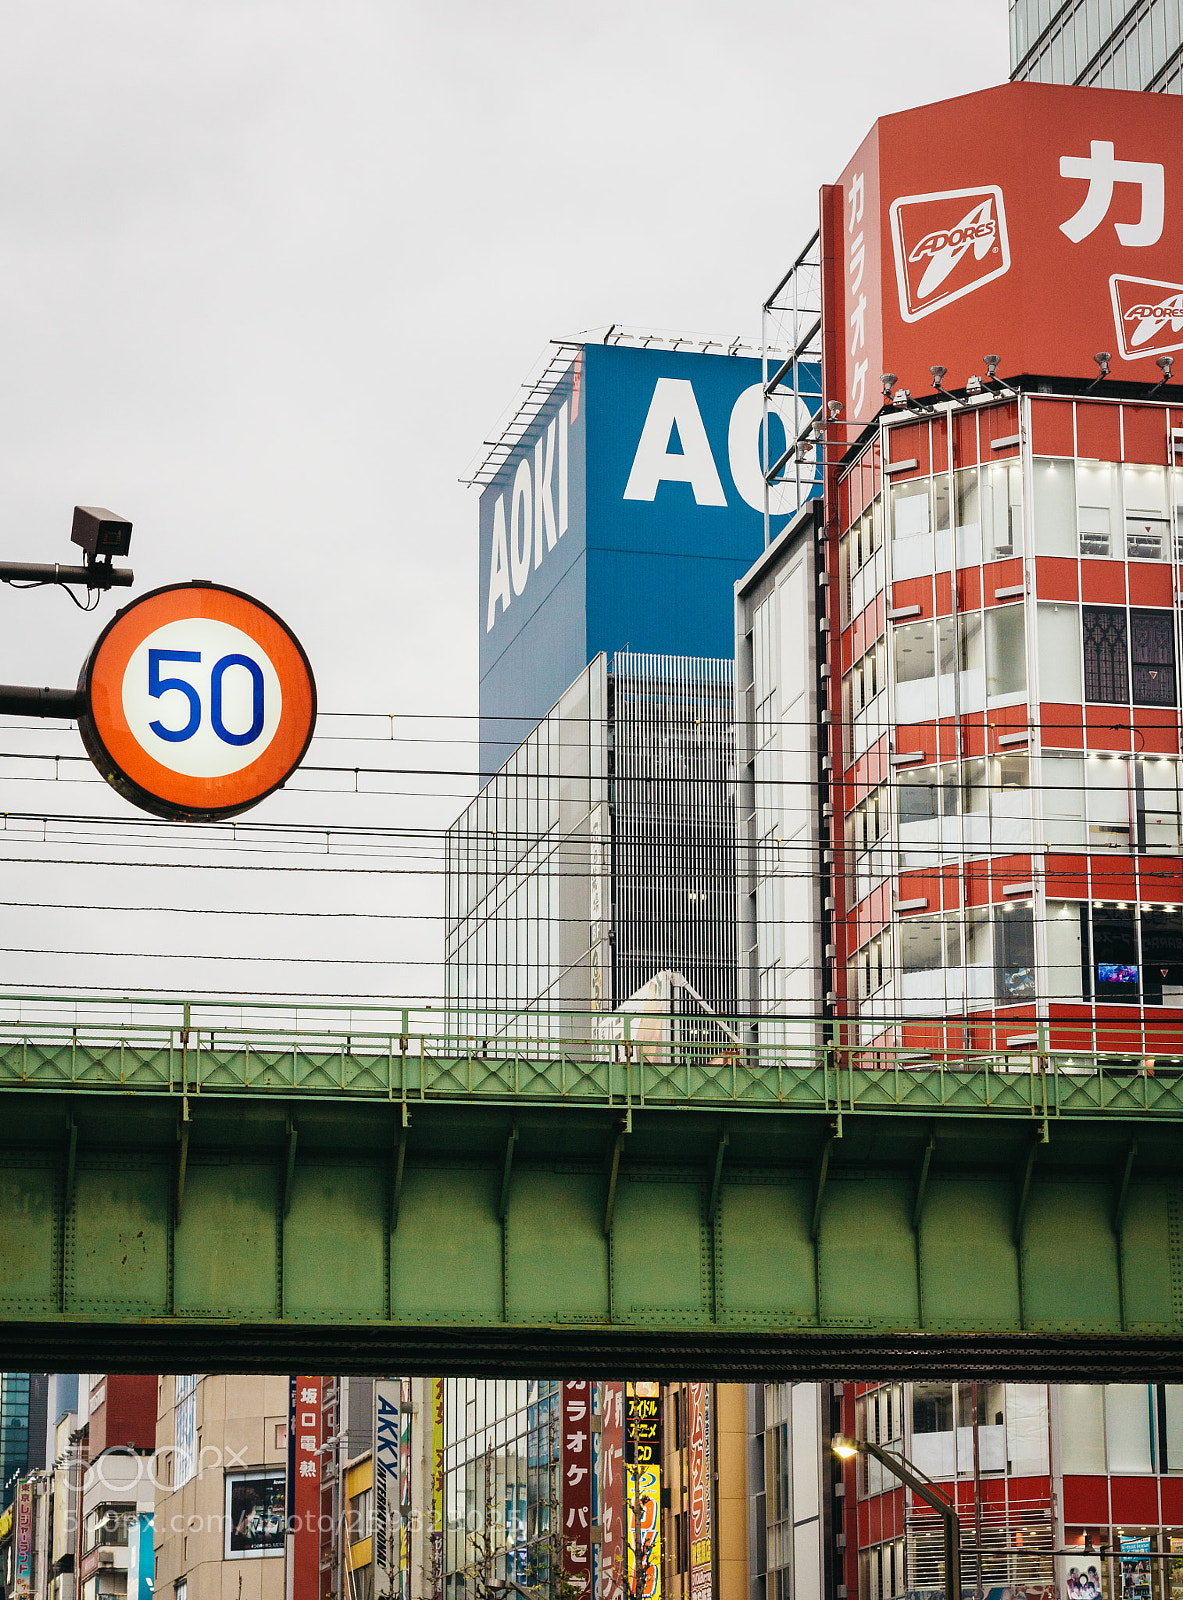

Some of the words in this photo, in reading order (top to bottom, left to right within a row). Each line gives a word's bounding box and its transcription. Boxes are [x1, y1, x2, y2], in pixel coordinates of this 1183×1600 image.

[1059, 139, 1165, 247] カ
[909, 221, 995, 262] ADORES
[848, 172, 869, 419] カラオケ
[486, 399, 569, 634] AOKI
[148, 648, 265, 747] 50
[300, 1388, 319, 1478] 坂口電熱
[377, 1394, 399, 1480] AKKY
[635, 1445, 653, 1461] CD
[18, 1483, 31, 1575] 東京レジャーランド
[376, 1462, 387, 1569] INTERNATIONAL
